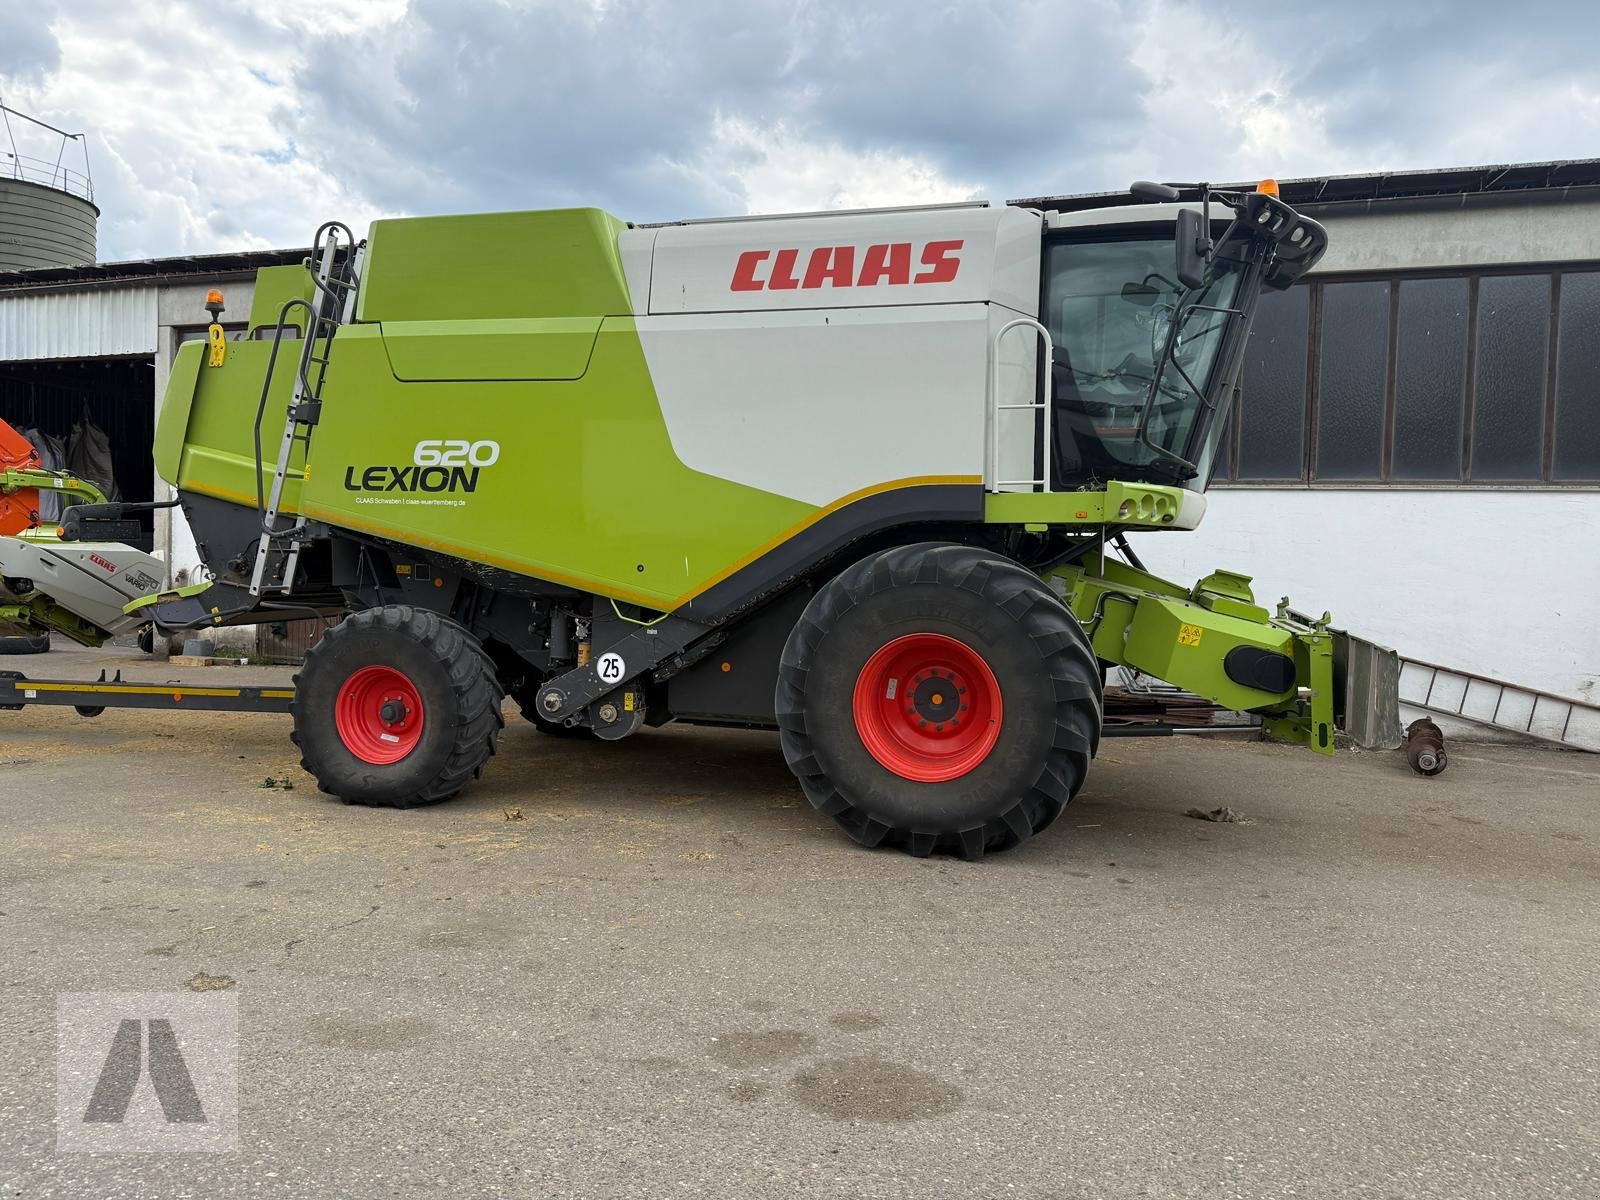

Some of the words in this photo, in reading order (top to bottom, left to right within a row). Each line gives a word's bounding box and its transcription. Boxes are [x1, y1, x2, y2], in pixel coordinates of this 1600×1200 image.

[730, 240, 964, 291] CLAAS
[414, 440, 500, 467] 620
[344, 466, 480, 492] LEXION
[405, 498, 466, 506] claas-wuerttemberg.de
[89, 554, 117, 573] CLAAS
[124, 574, 146, 591] VARIO
[602, 658, 620, 678] 25
